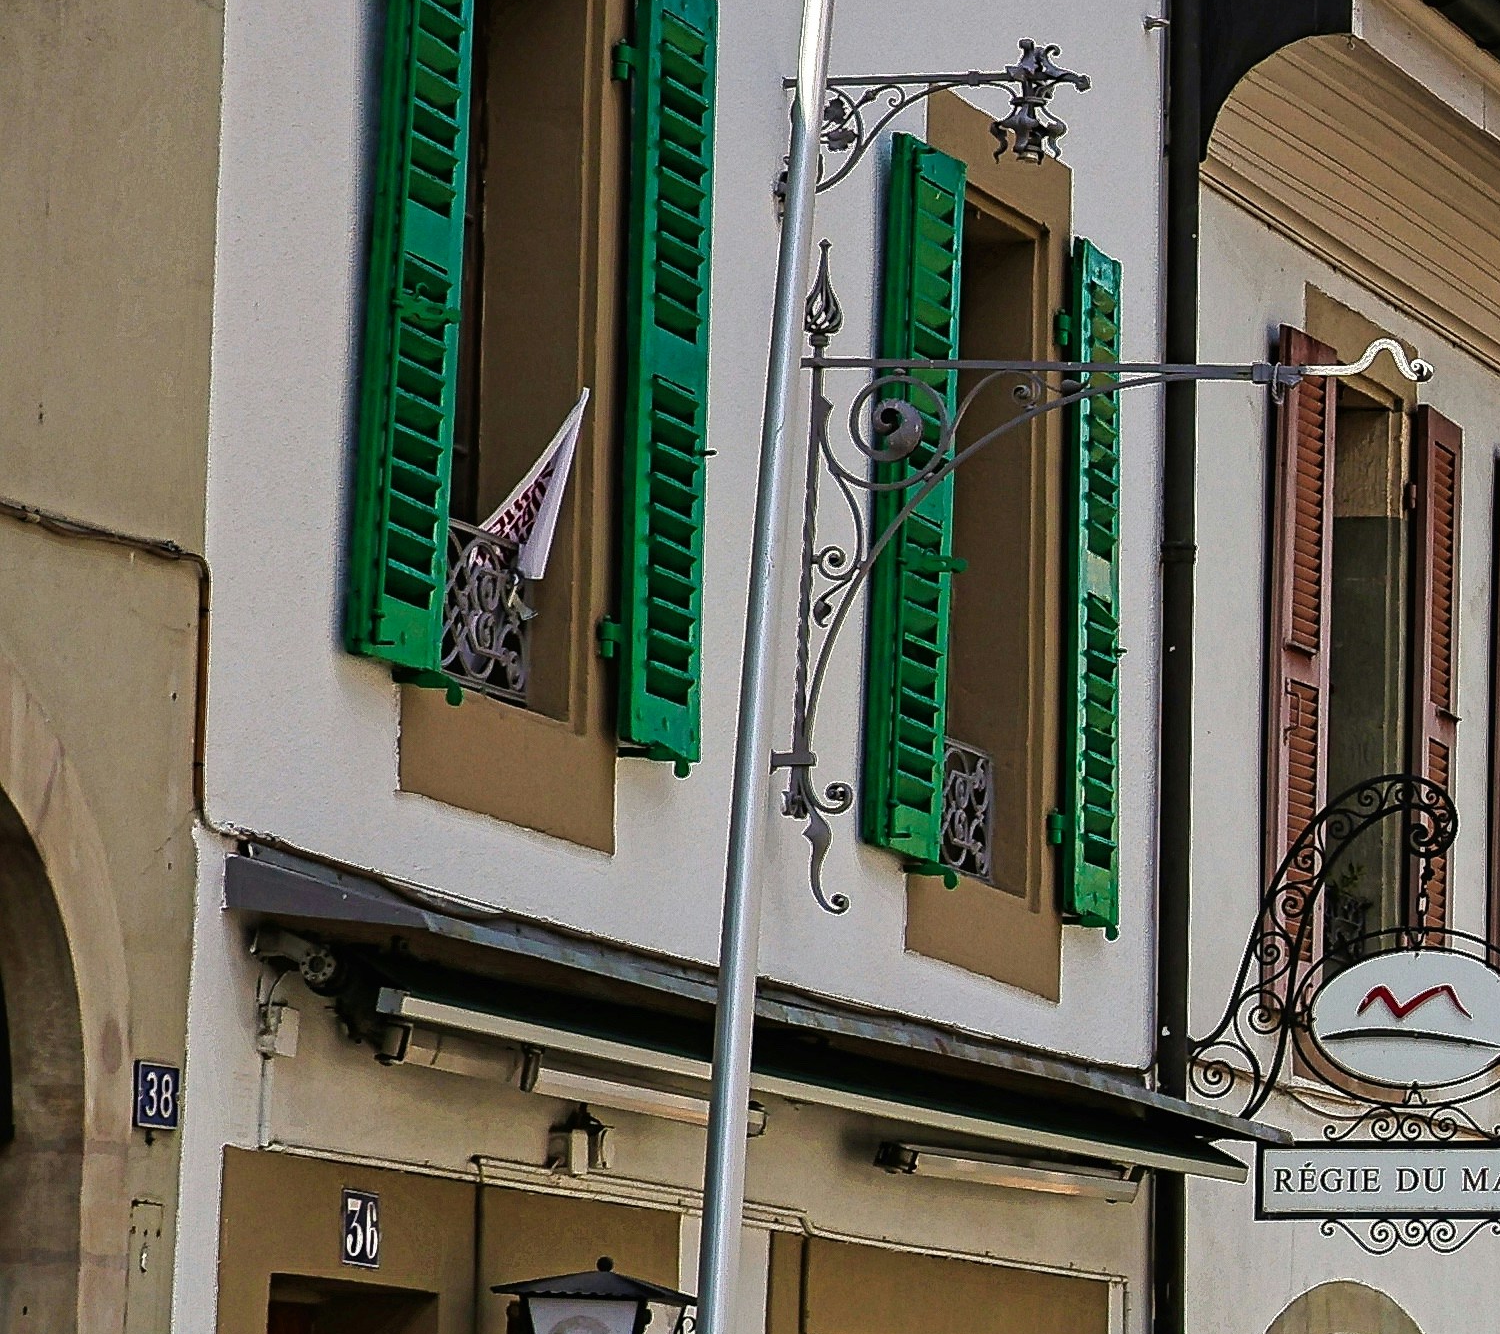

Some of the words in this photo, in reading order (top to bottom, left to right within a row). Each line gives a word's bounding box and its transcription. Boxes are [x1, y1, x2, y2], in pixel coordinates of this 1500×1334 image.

[144, 1071, 173, 1118] 38
[1273, 1162, 1381, 1194] RÉGIE
[1395, 1168, 1446, 1194] DU
[345, 1200, 378, 1259] 36
